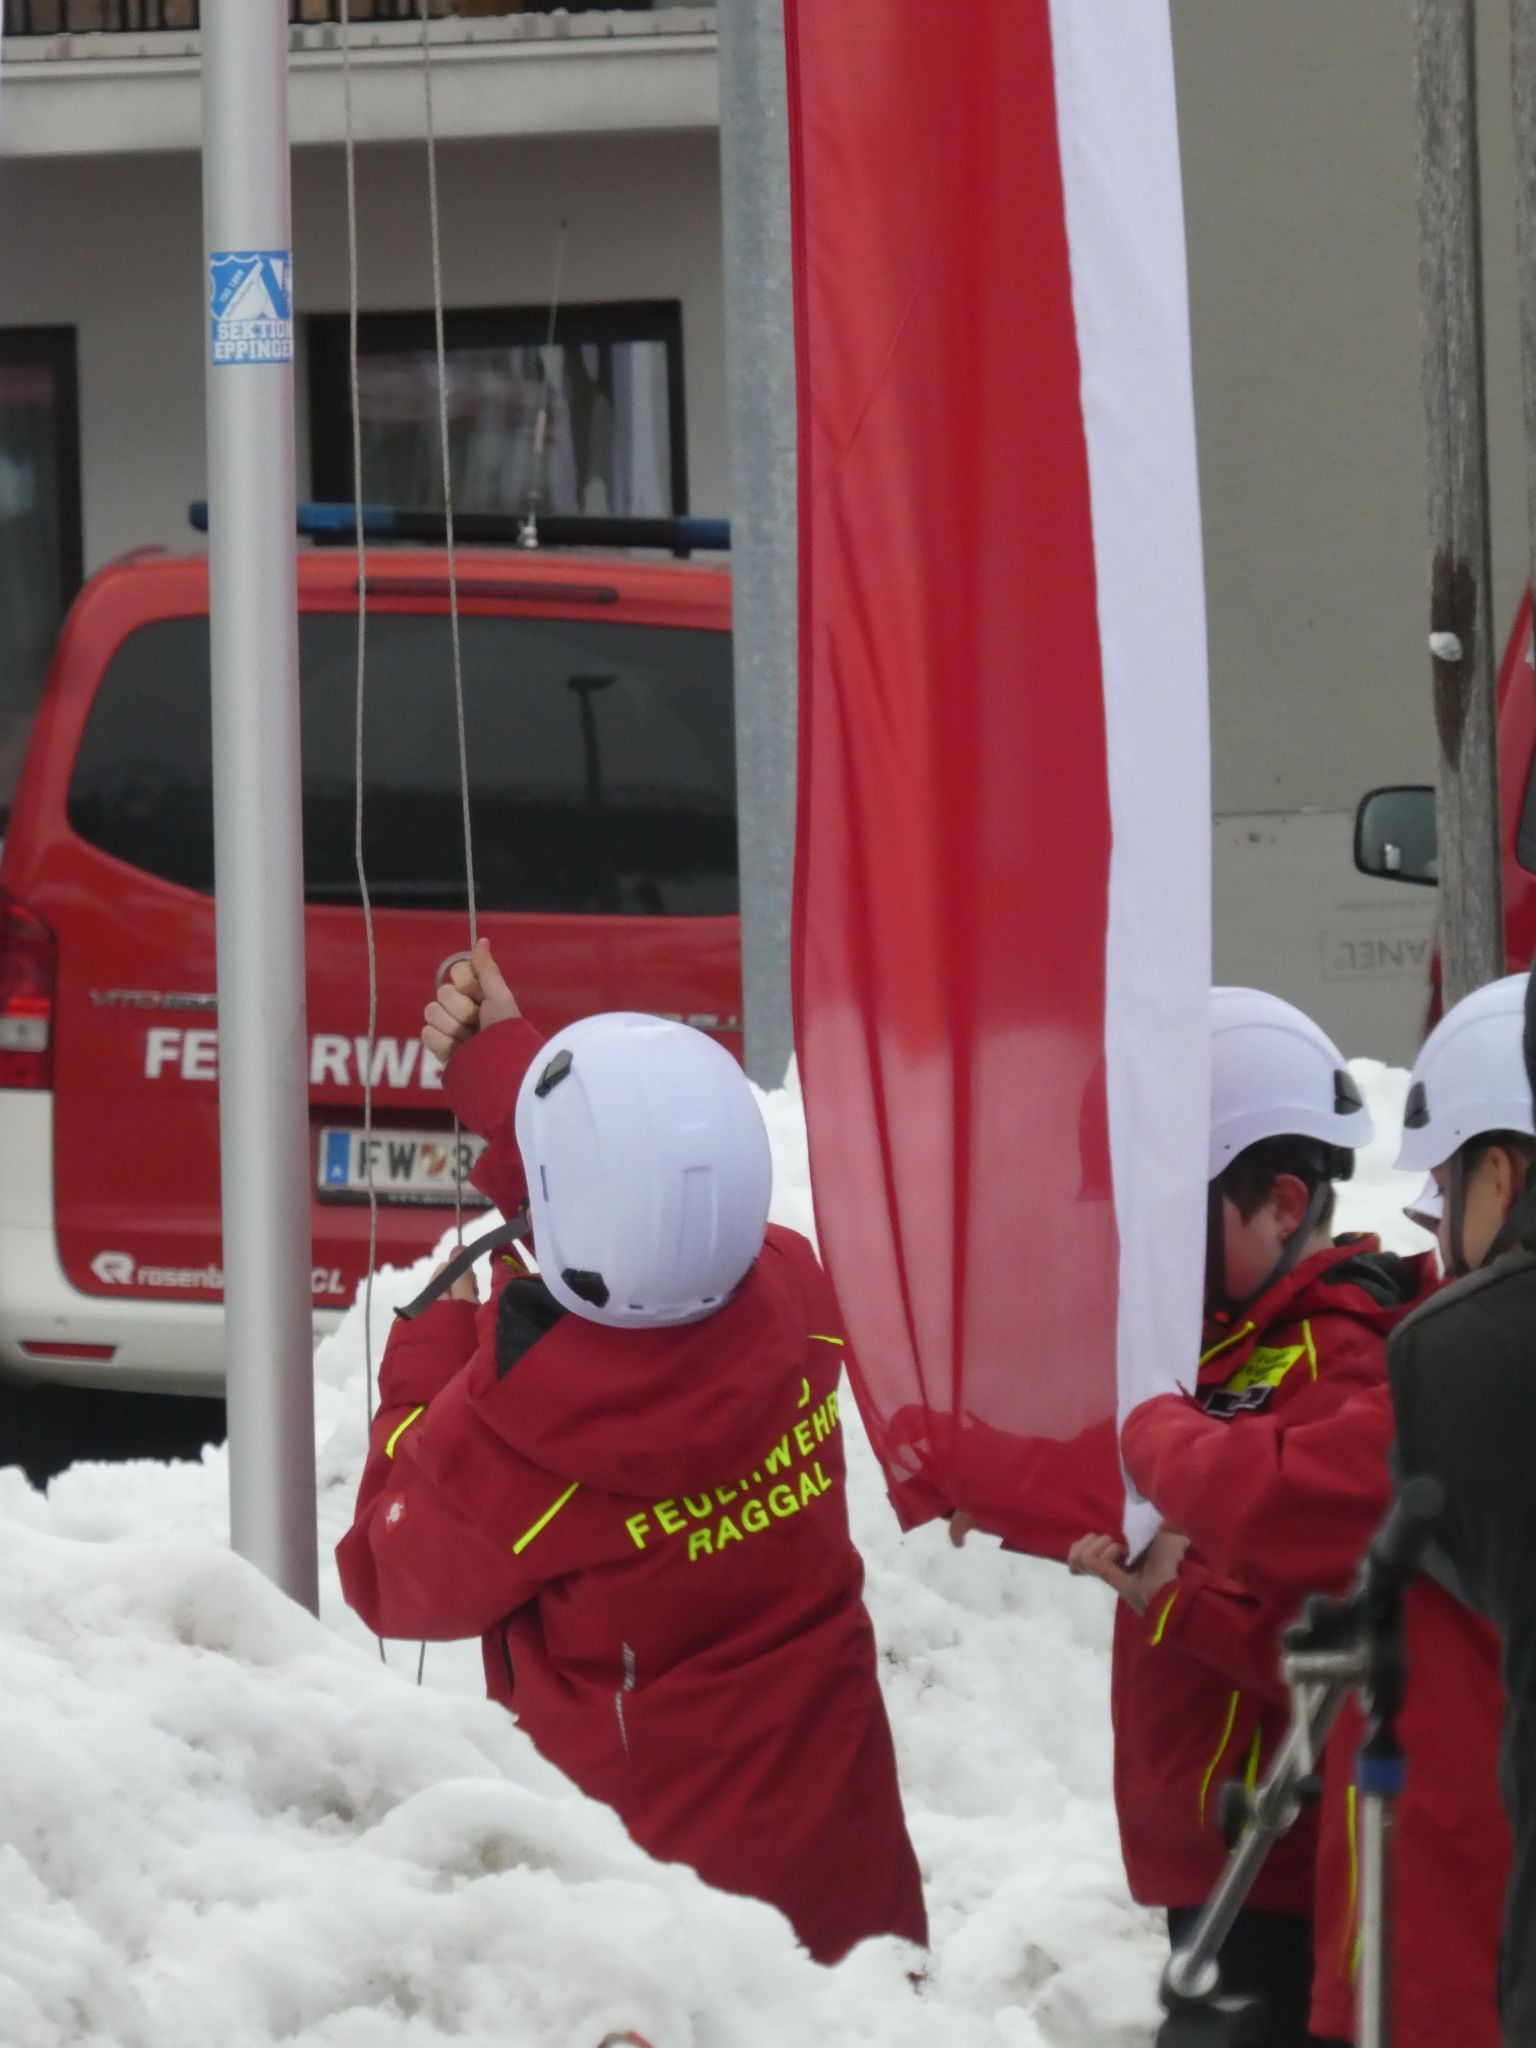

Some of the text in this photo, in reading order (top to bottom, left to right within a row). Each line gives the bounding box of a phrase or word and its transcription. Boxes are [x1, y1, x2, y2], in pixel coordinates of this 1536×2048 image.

[358, 1140, 417, 1181] FW
[138, 1263, 223, 1289] rosenb
[687, 1461, 833, 1561] RAGGAL
